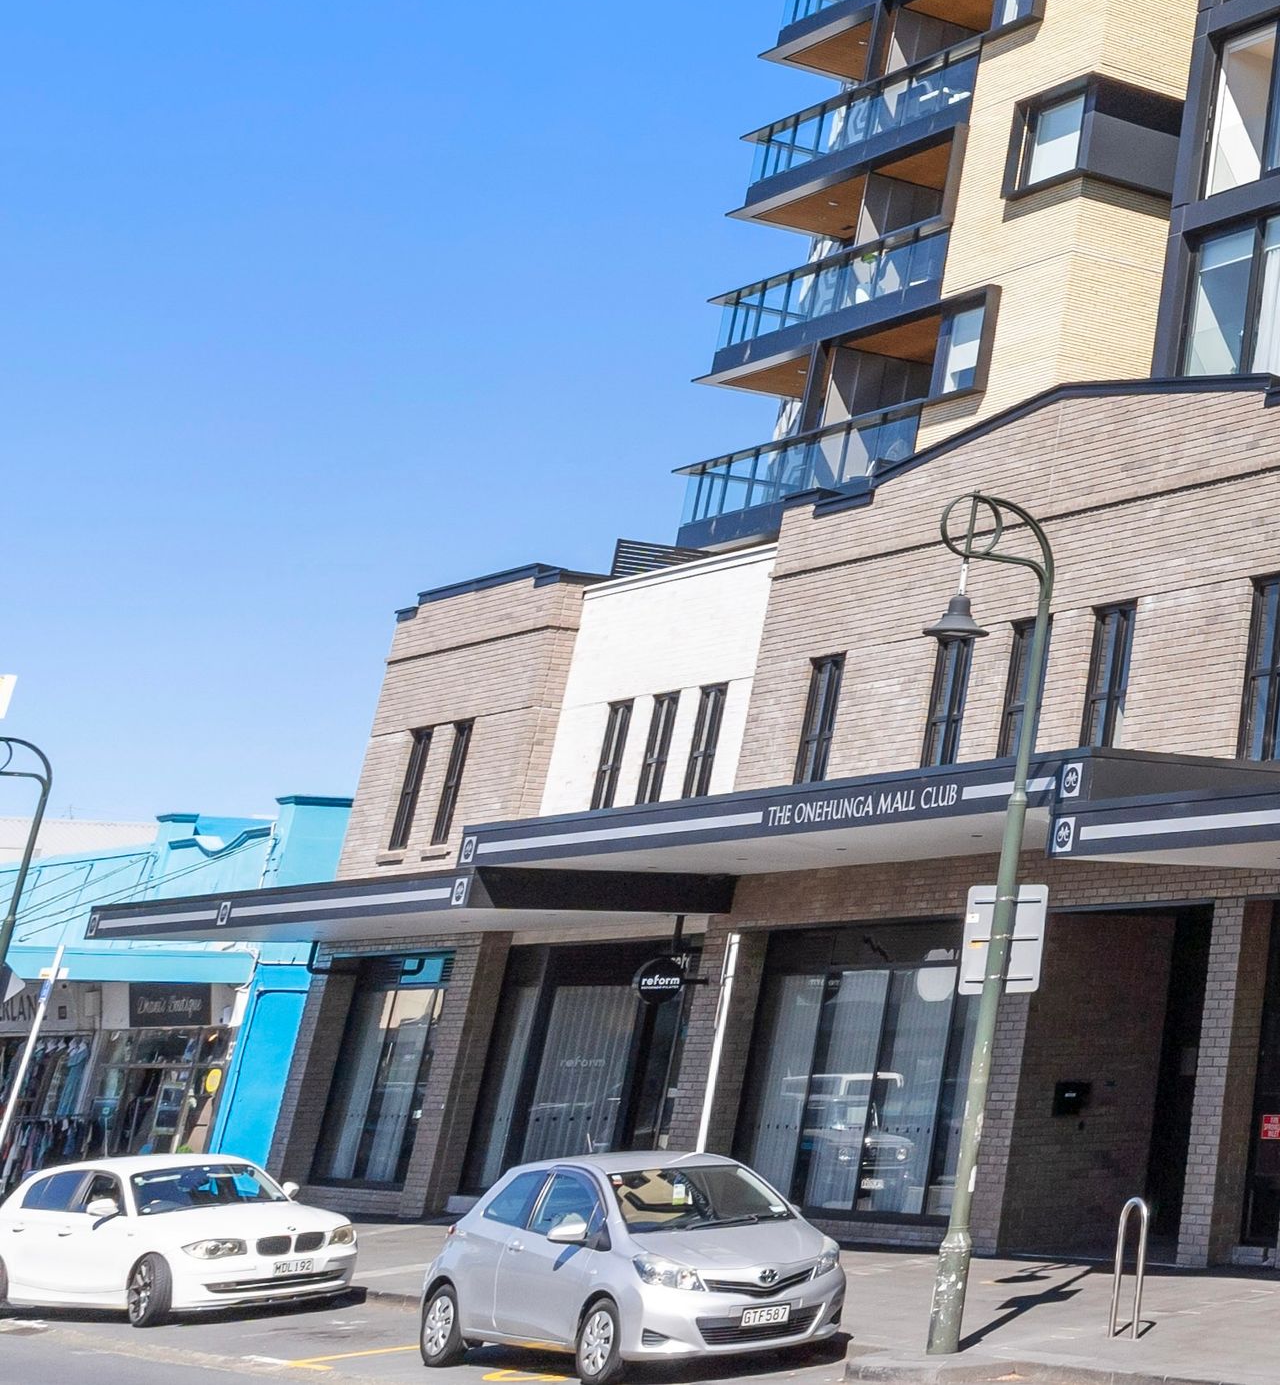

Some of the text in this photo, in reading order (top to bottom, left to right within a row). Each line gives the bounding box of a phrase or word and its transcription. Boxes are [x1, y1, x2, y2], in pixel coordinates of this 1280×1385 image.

[768, 784, 957, 827] THE ONEHUNGA MALL CLUB
[641, 974, 681, 986] reform
[559, 1055, 606, 1068] reform
[743, 1306, 787, 1325] GTF587
